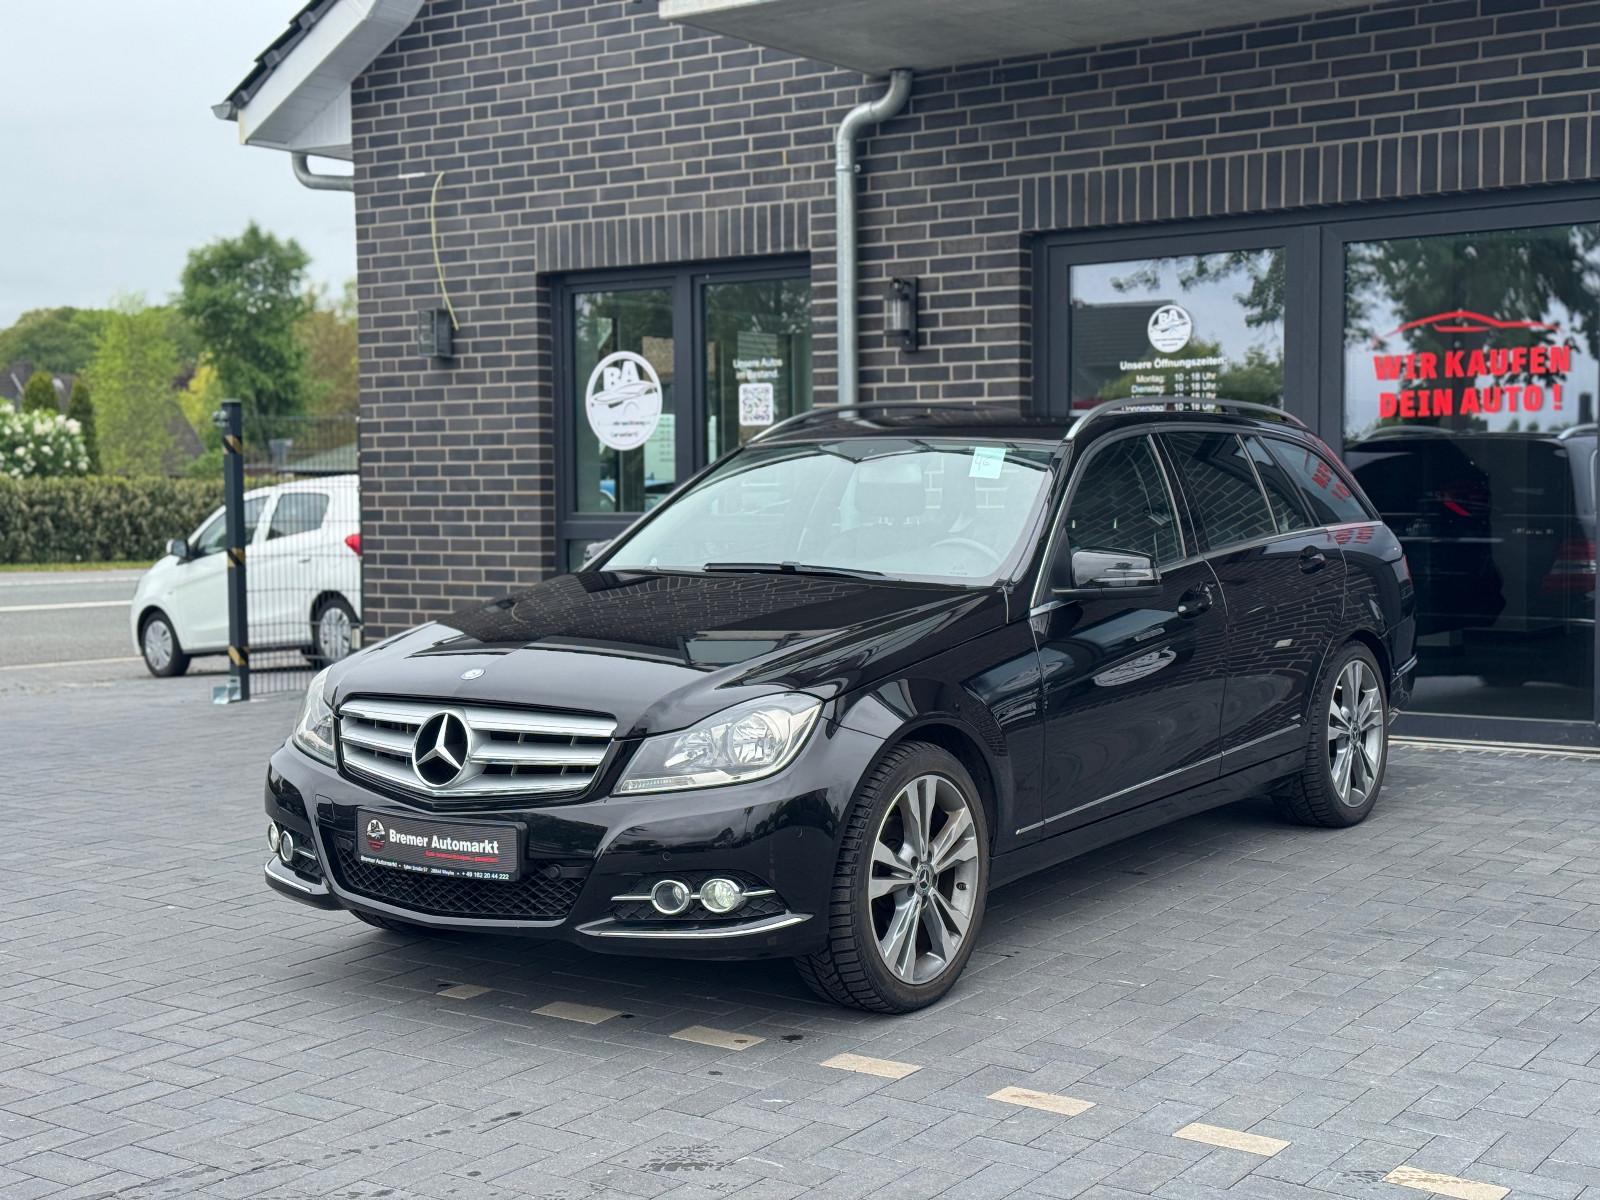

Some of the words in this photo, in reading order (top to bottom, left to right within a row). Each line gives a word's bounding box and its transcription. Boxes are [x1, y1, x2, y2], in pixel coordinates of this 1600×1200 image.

[1120, 361, 1152, 370] Unsere
[1373, 352, 1437, 381] WIR
[1445, 345, 1571, 378] KAUFEN
[603, 360, 641, 391] BA
[1174, 373, 1184, 381] 10
[1202, 372, 1217, 380] Uhr
[1174, 383, 1184, 391] 10
[1202, 382, 1217, 390] Uhr
[1174, 403, 1184, 411] 10
[1379, 389, 1453, 418] DEIN
[1460, 384, 1543, 415] AUTO
[1553, 384, 1562, 411] !
[389, 829, 428, 847] Bremer
[431, 835, 499, 854] Automarkt
